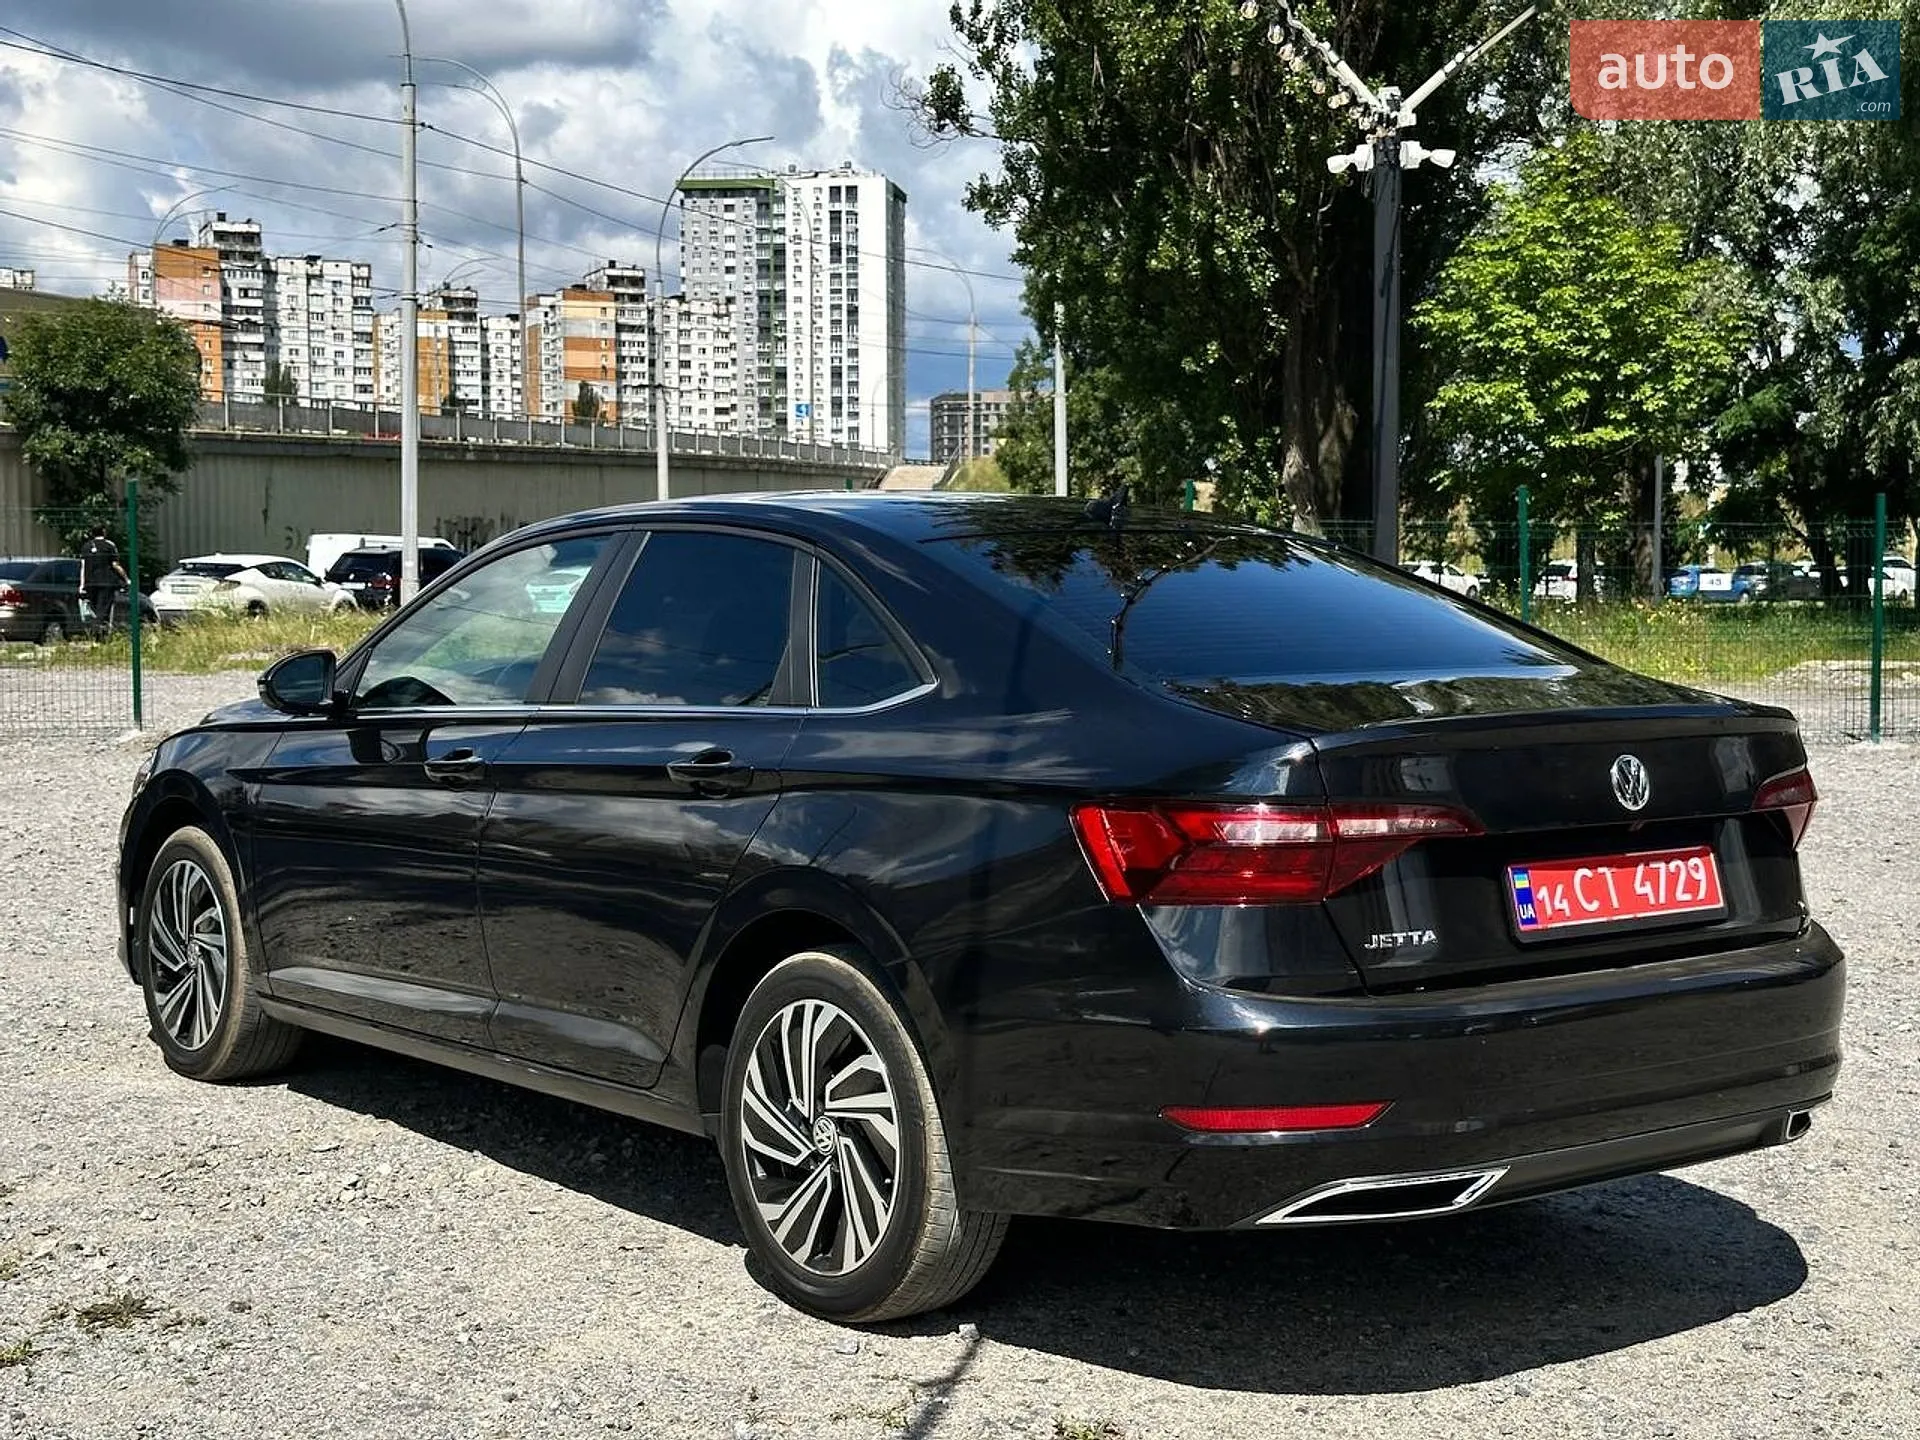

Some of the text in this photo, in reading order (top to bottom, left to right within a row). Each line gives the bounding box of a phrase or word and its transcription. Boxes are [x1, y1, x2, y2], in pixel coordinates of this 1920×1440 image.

[1536, 857, 1708, 920] 14 CT 4729
[1519, 903, 1536, 919] UA
[1364, 929, 1438, 949] JETTA
